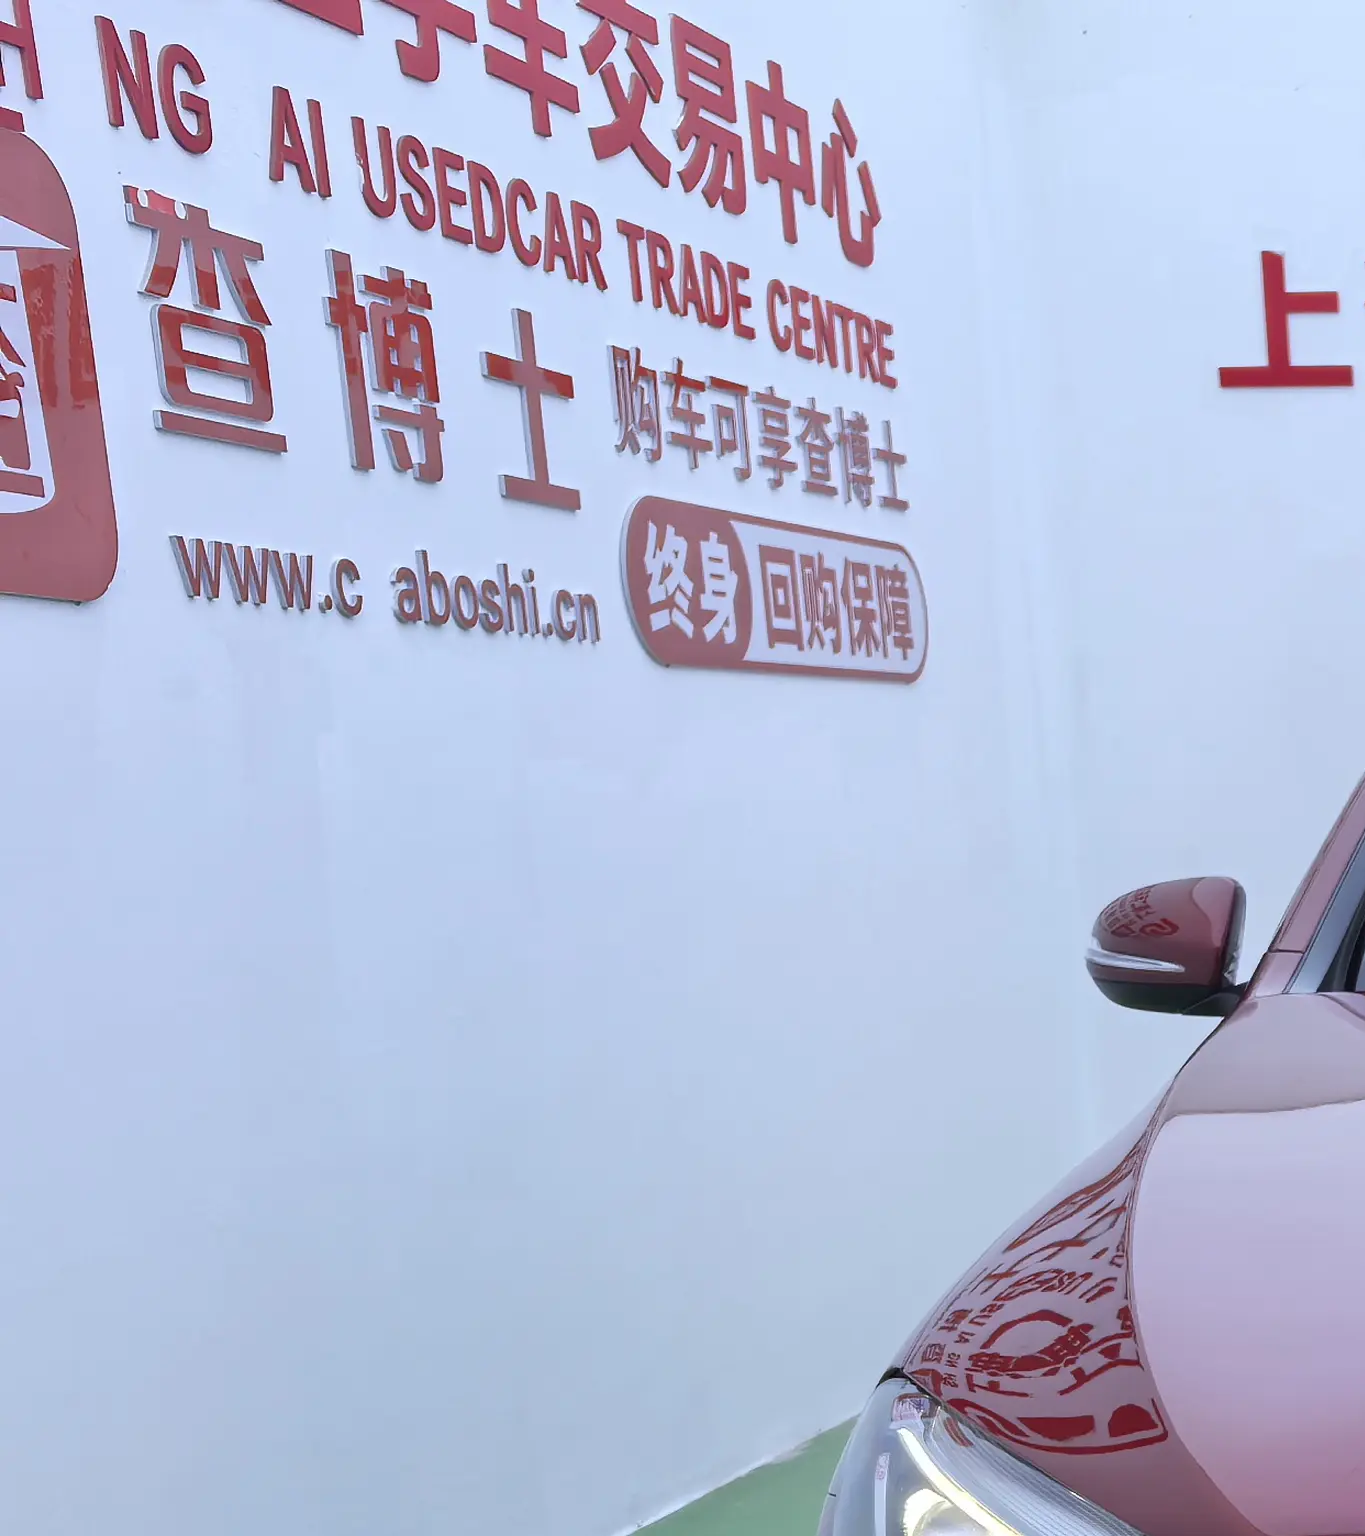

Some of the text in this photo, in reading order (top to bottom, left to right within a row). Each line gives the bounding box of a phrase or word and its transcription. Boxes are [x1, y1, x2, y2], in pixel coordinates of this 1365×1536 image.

[96, 16, 213, 154] NG
[269, 86, 332, 199] AI
[351, 116, 608, 291] USEDCAR
[616, 219, 756, 340] TRADE
[767, 279, 899, 389] CENTRE
[277, 0, 881, 267] 车交易中心
[123, 185, 581, 512] 查博士
[607, 344, 909, 511] 购车可享查博士
[645, 519, 915, 661] 终身 回购保障
